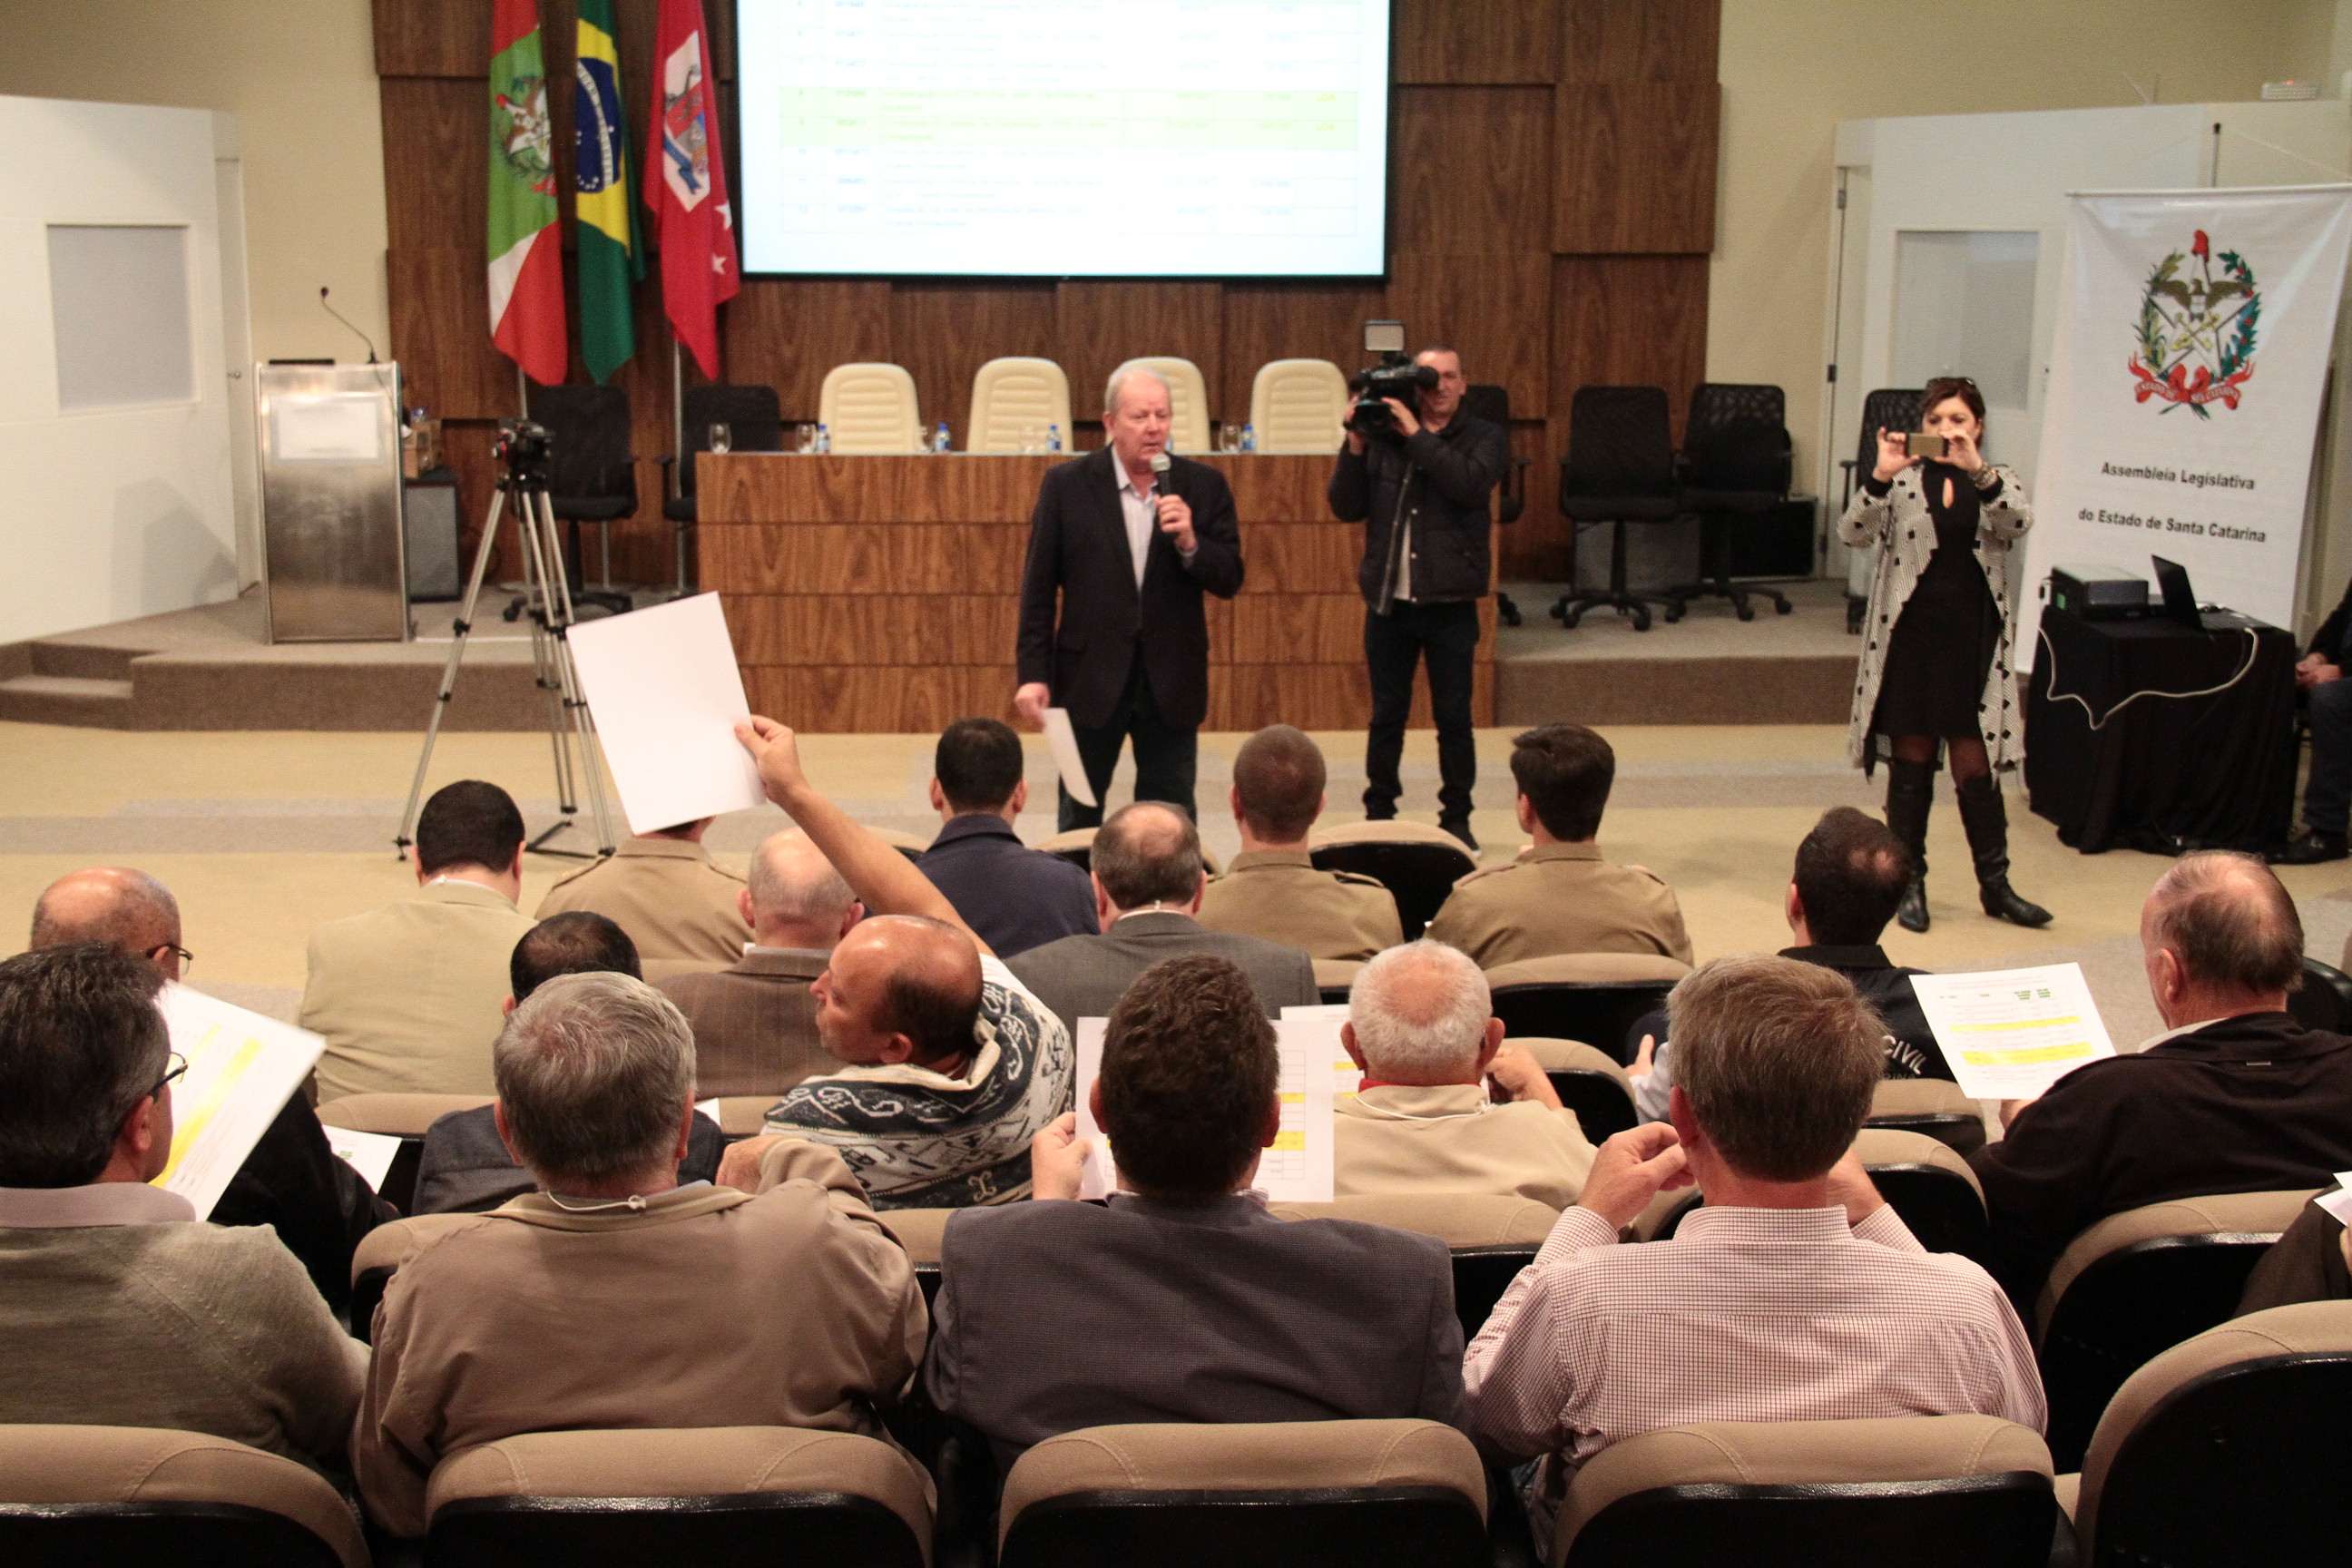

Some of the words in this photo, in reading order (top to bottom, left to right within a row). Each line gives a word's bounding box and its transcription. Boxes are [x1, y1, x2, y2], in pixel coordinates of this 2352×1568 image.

[2102, 462, 2176, 482] Assembleia
[2180, 470, 2255, 490] Legislativa
[2078, 508, 2093, 521] do
[2098, 509, 2141, 527] Estado
[2146, 516, 2161, 530] de
[2166, 517, 2204, 535] Santa
[2209, 523, 2266, 543] Catarina
[1882, 1034, 1926, 1075] CIVIL
